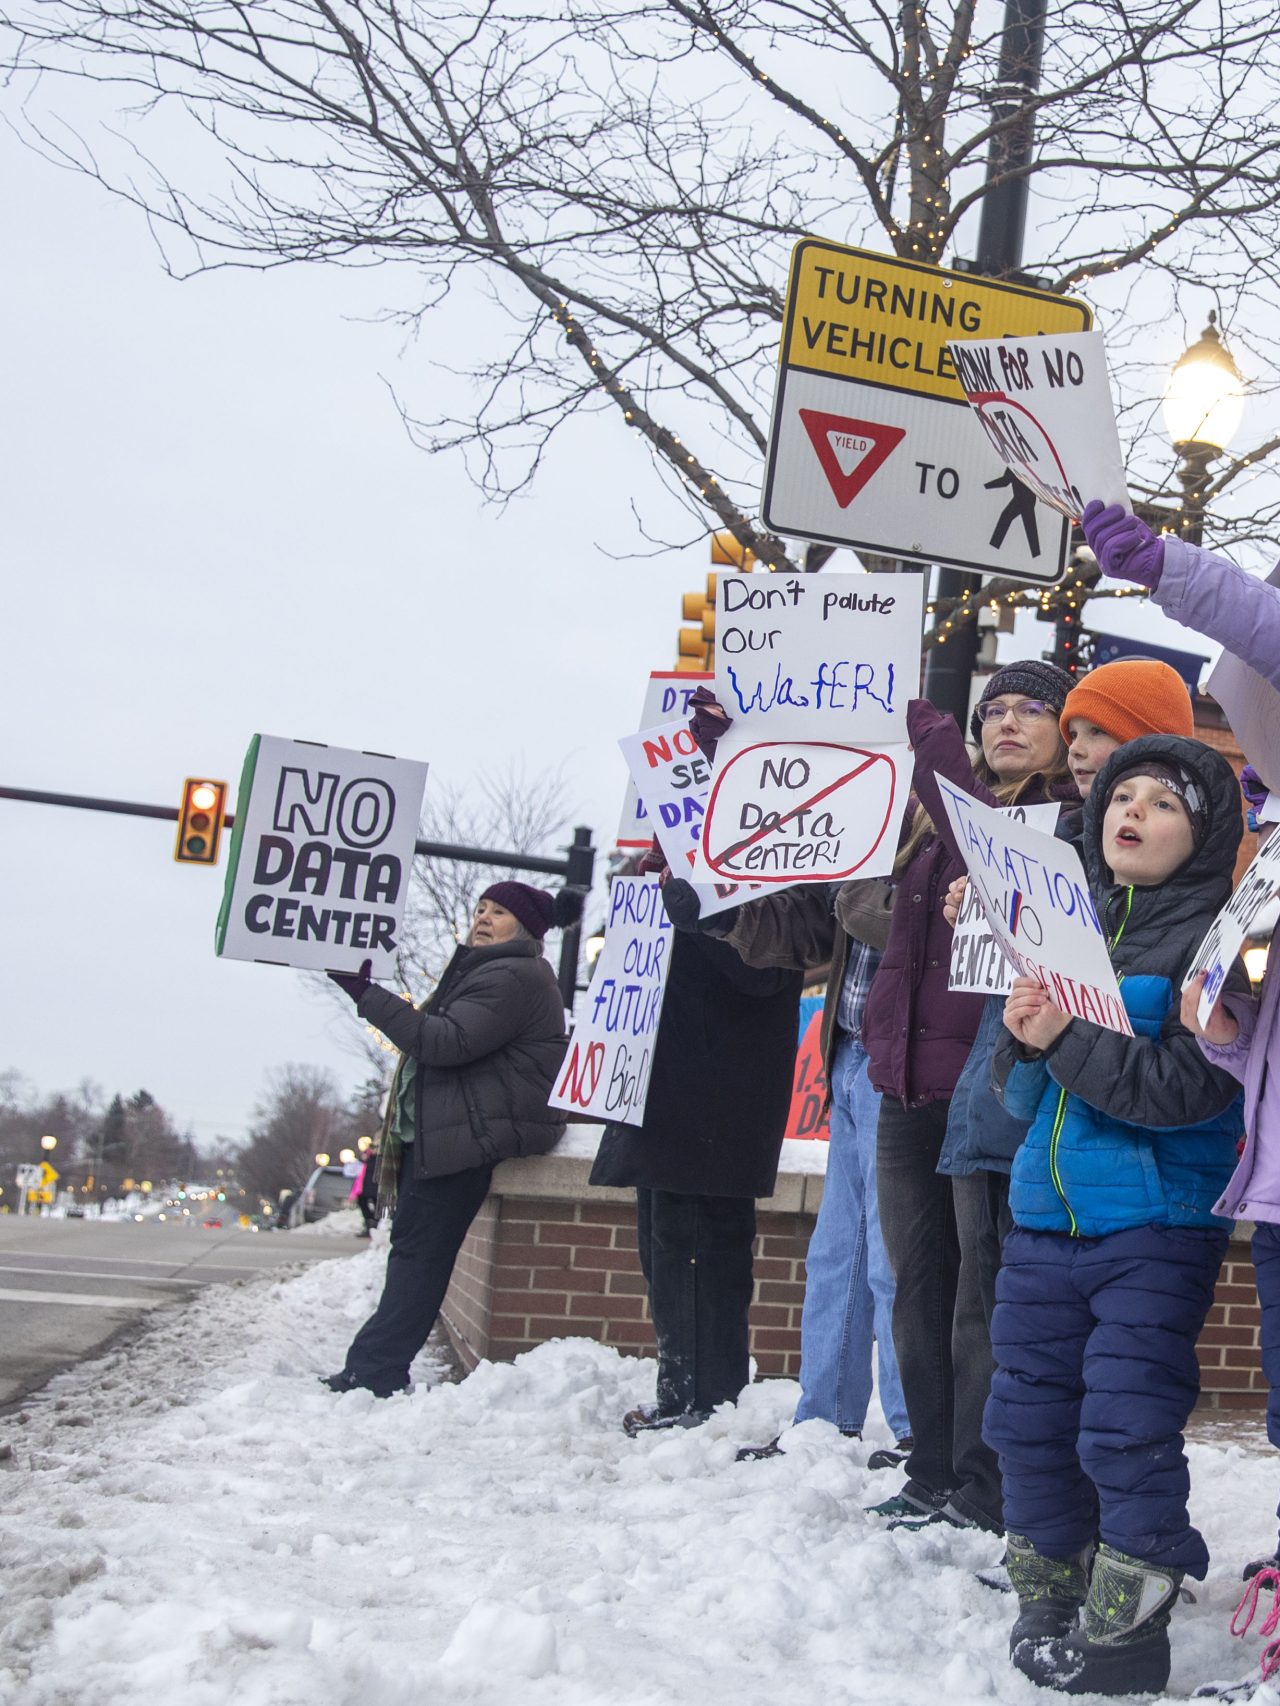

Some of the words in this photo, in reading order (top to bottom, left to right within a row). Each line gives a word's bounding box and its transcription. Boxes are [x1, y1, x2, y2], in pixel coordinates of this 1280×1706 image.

[814, 266, 982, 332] TURNING
[802, 316, 957, 380] VEHICLE
[997, 346, 1034, 391] FOR
[1042, 348, 1084, 388] NO
[834, 435, 867, 452] YIELD
[915, 462, 960, 499] TO
[642, 729, 698, 768] NO
[760, 757, 810, 789] NO
[273, 766, 396, 849] NO
[253, 834, 401, 904] DATA
[940, 783, 1102, 935] TAXATION
[244, 894, 397, 953] CENTER
[623, 936, 665, 982] OUR
[592, 979, 663, 1036] FUTUR
[558, 1041, 605, 1107] NO
